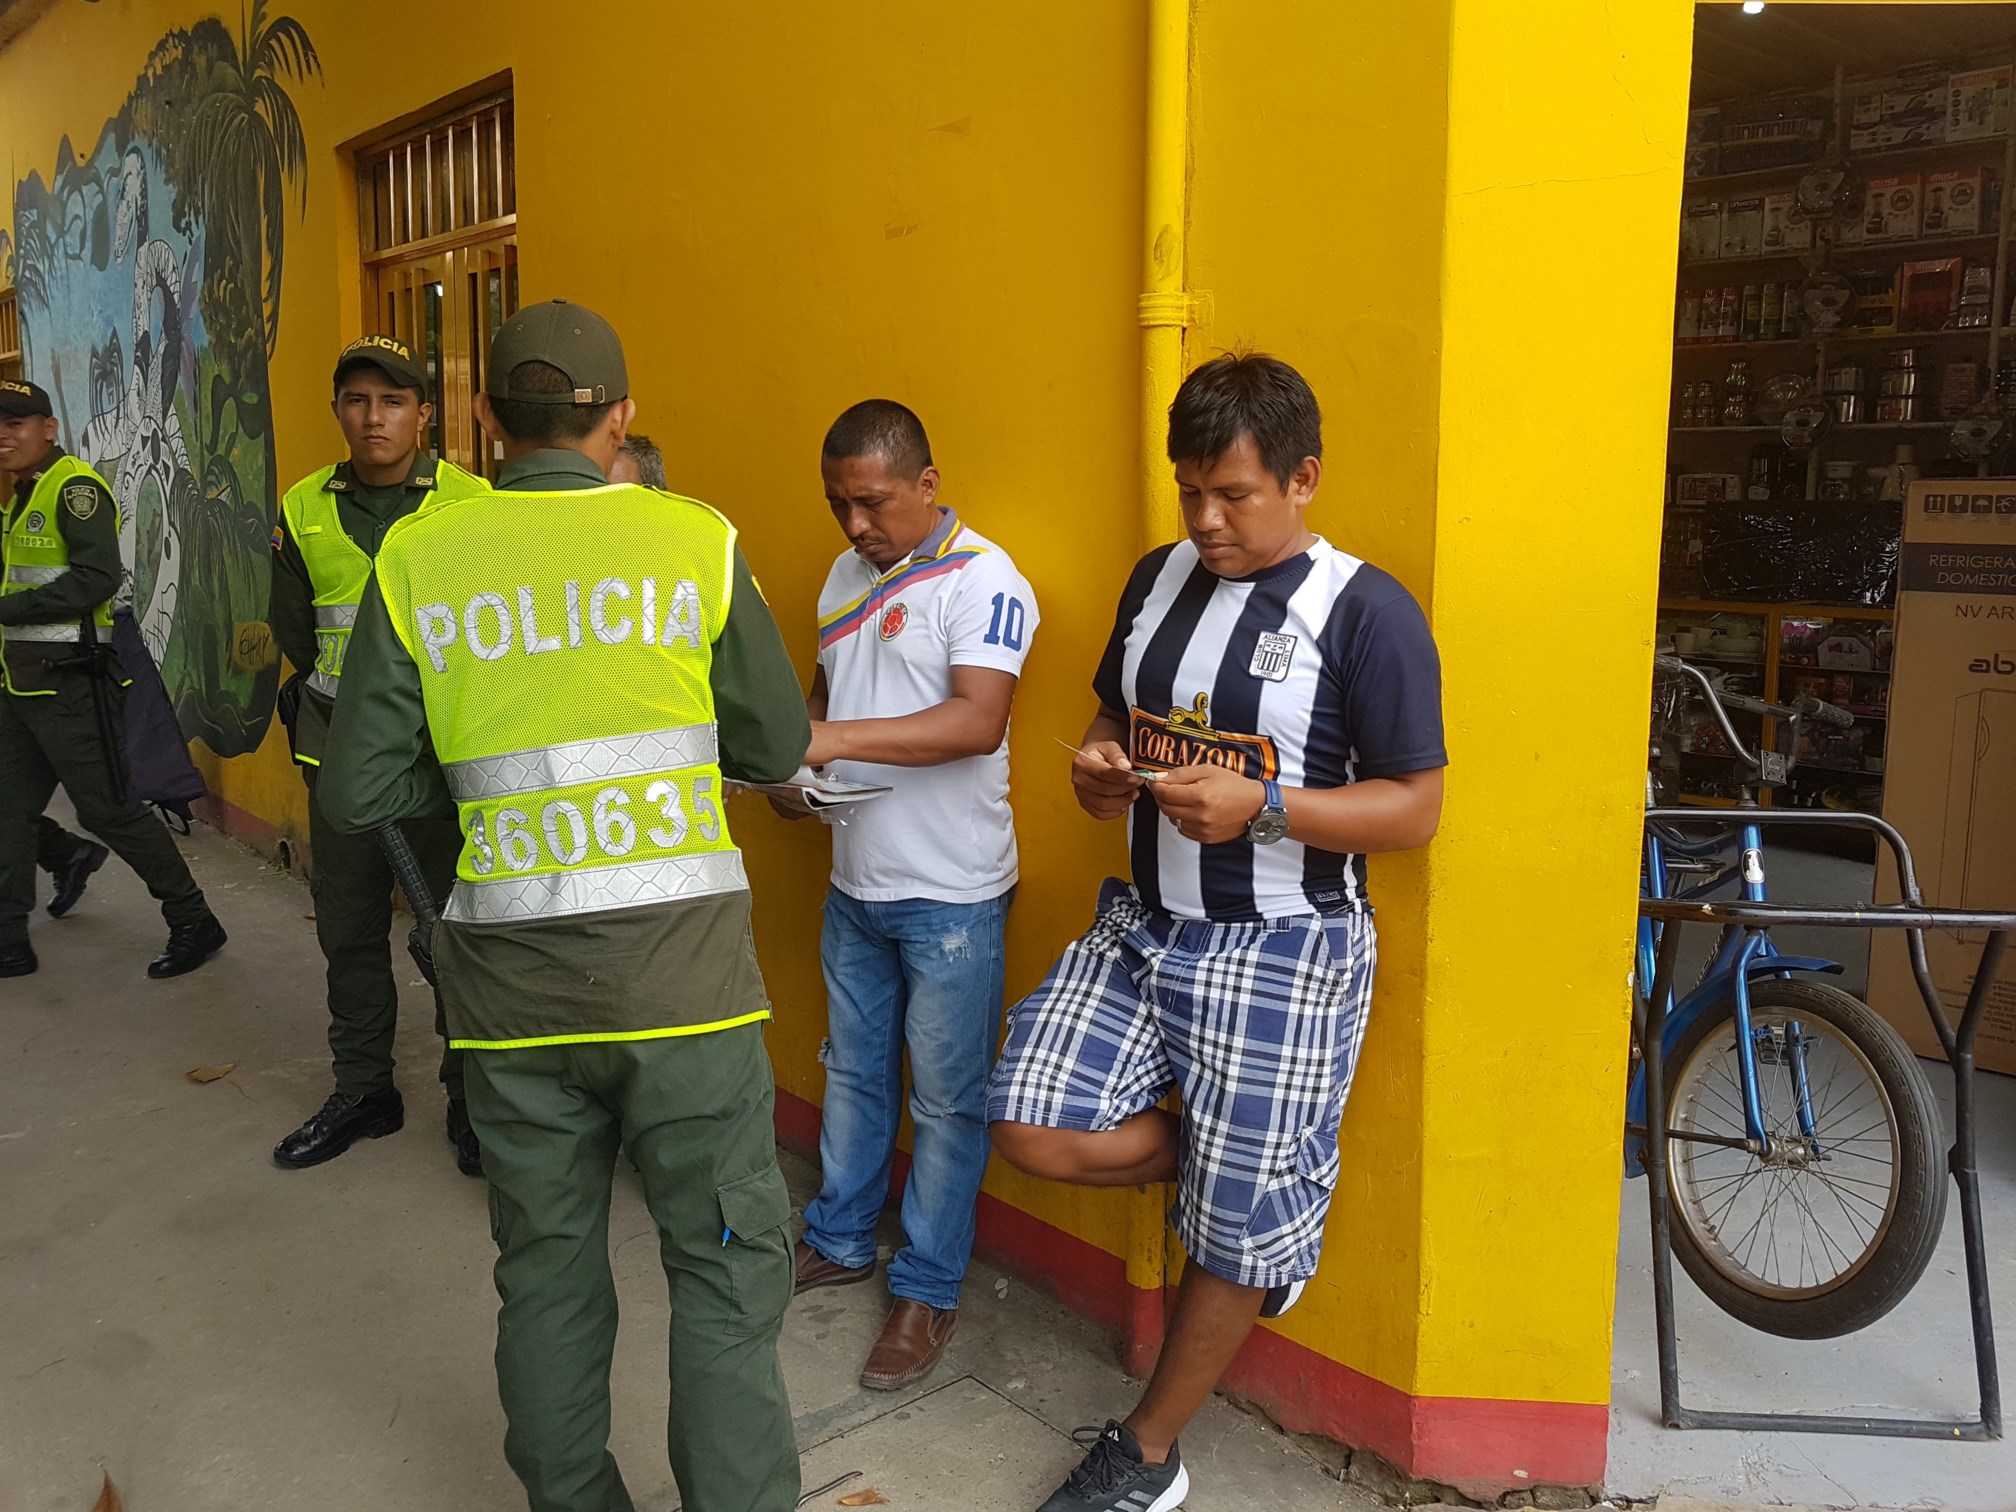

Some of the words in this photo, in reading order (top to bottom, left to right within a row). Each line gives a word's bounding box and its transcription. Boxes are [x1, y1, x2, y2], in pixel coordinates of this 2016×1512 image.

[1955, 604, 1983, 618] NV
[414, 577, 701, 673] POLICIA
[983, 592, 1025, 652] 10
[1263, 634, 1291, 644] ALIANZA
[1253, 644, 1264, 662] CLUB
[1280, 650, 1291, 667] LIMA
[467, 776, 720, 875] 360635
